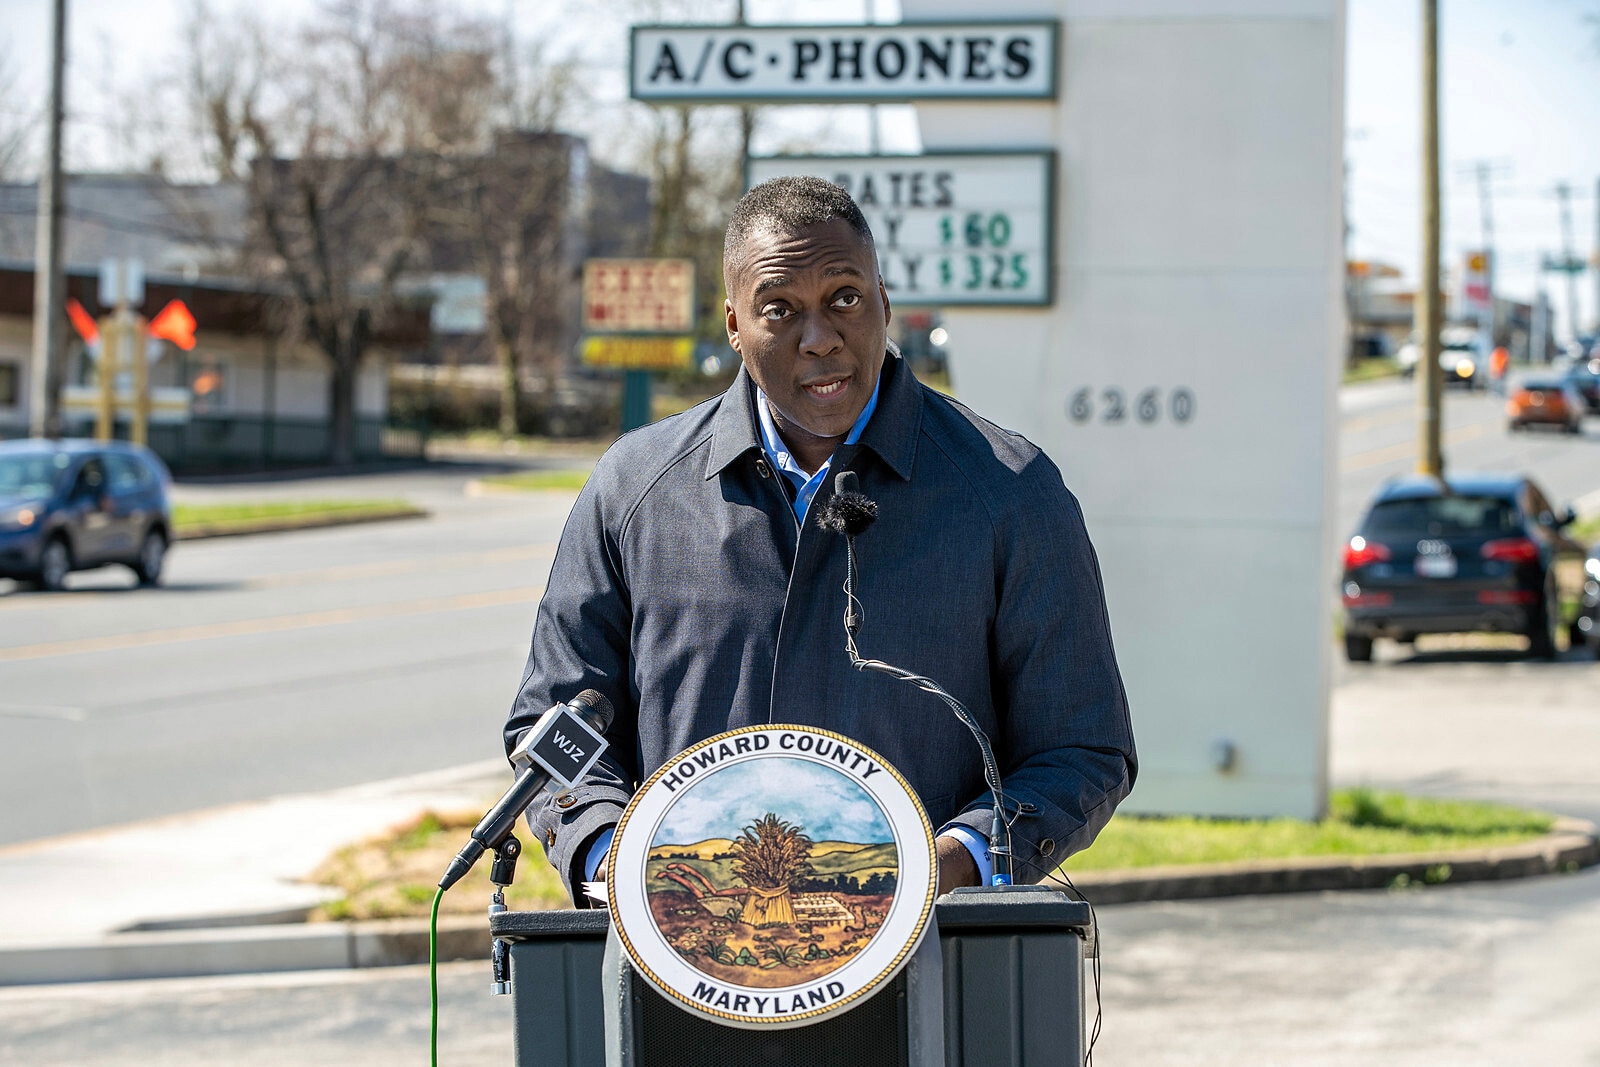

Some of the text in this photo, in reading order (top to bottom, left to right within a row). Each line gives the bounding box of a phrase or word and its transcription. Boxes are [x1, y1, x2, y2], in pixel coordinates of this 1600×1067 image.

[649, 37, 1033, 84] A/C PHONES
[1065, 385, 1198, 427] 6260
[552, 729, 586, 764] WJZ
[661, 733, 882, 793] HOWARD COUNTY
[691, 980, 845, 1014] MARYLAND
